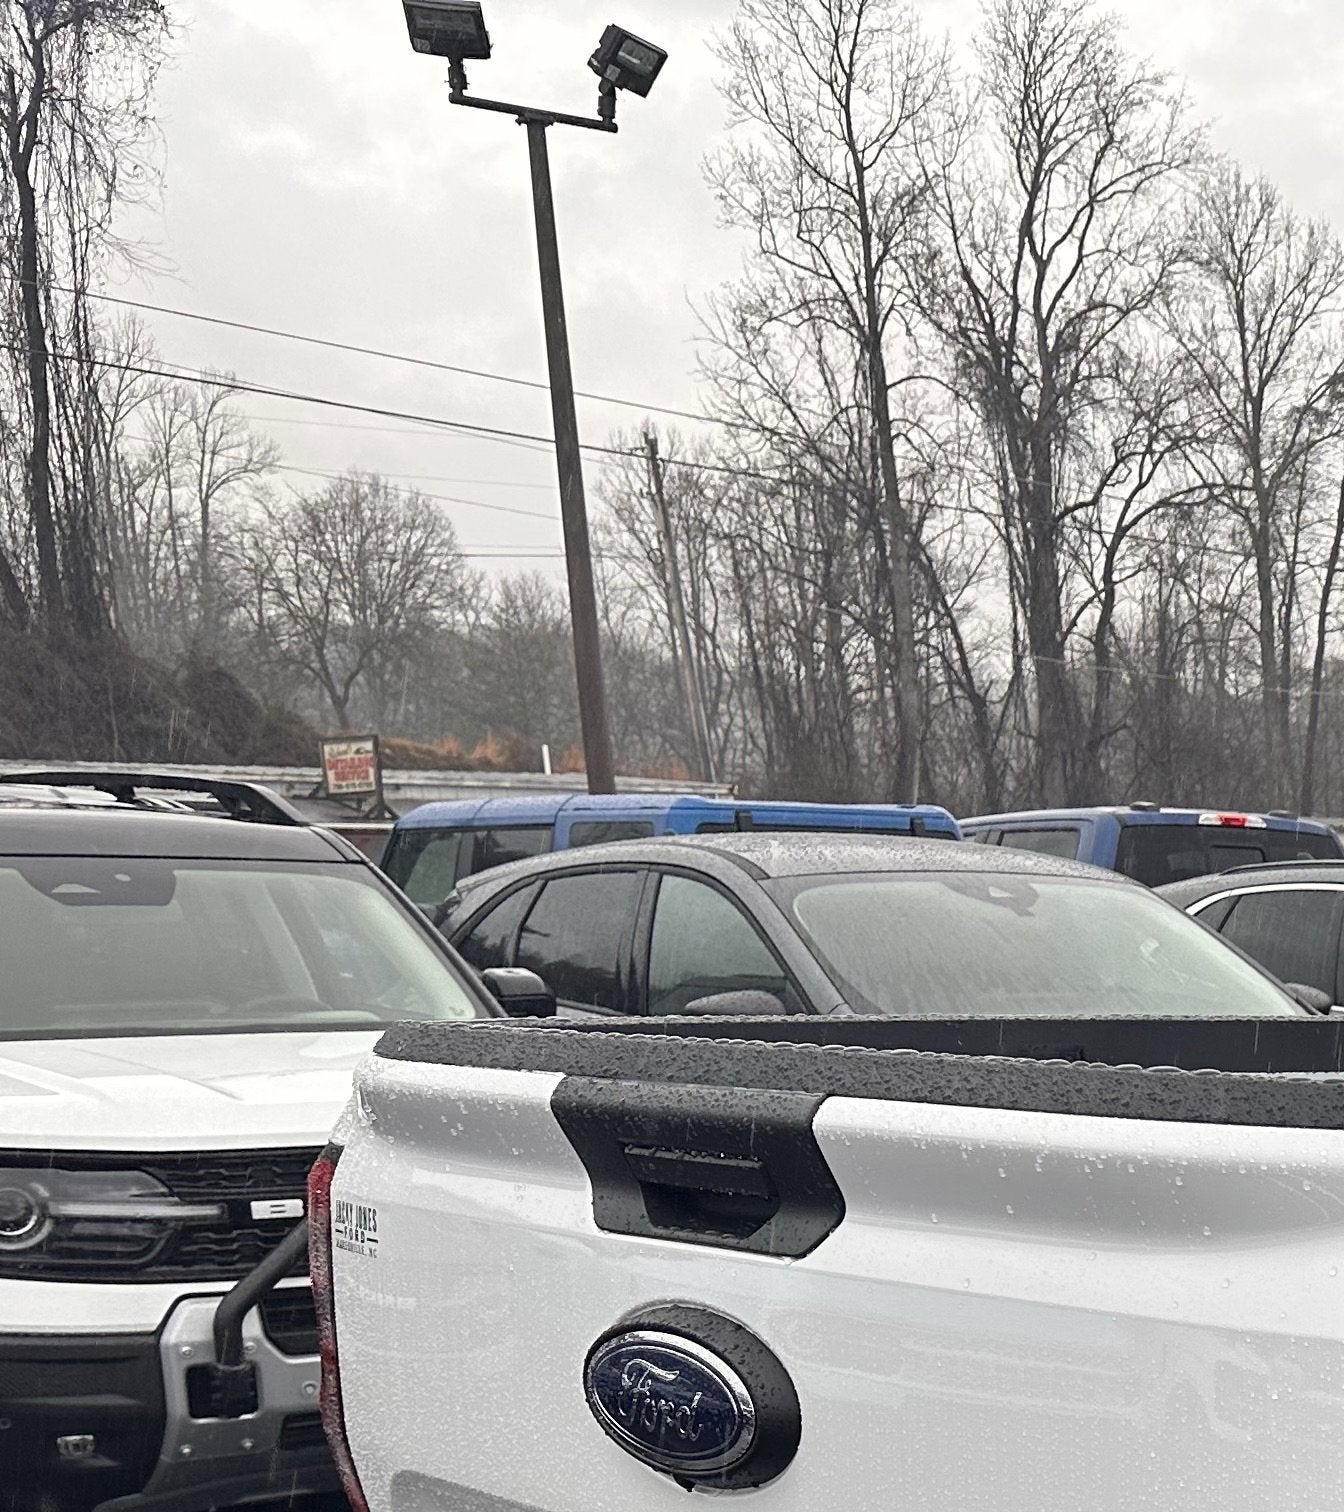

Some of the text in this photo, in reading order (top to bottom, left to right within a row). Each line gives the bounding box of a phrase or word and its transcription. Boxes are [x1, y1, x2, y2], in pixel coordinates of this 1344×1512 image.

[355, 1205, 377, 1232] JONES
[344, 1226, 365, 1243] FORD
[618, 1358, 702, 1441] Ford
